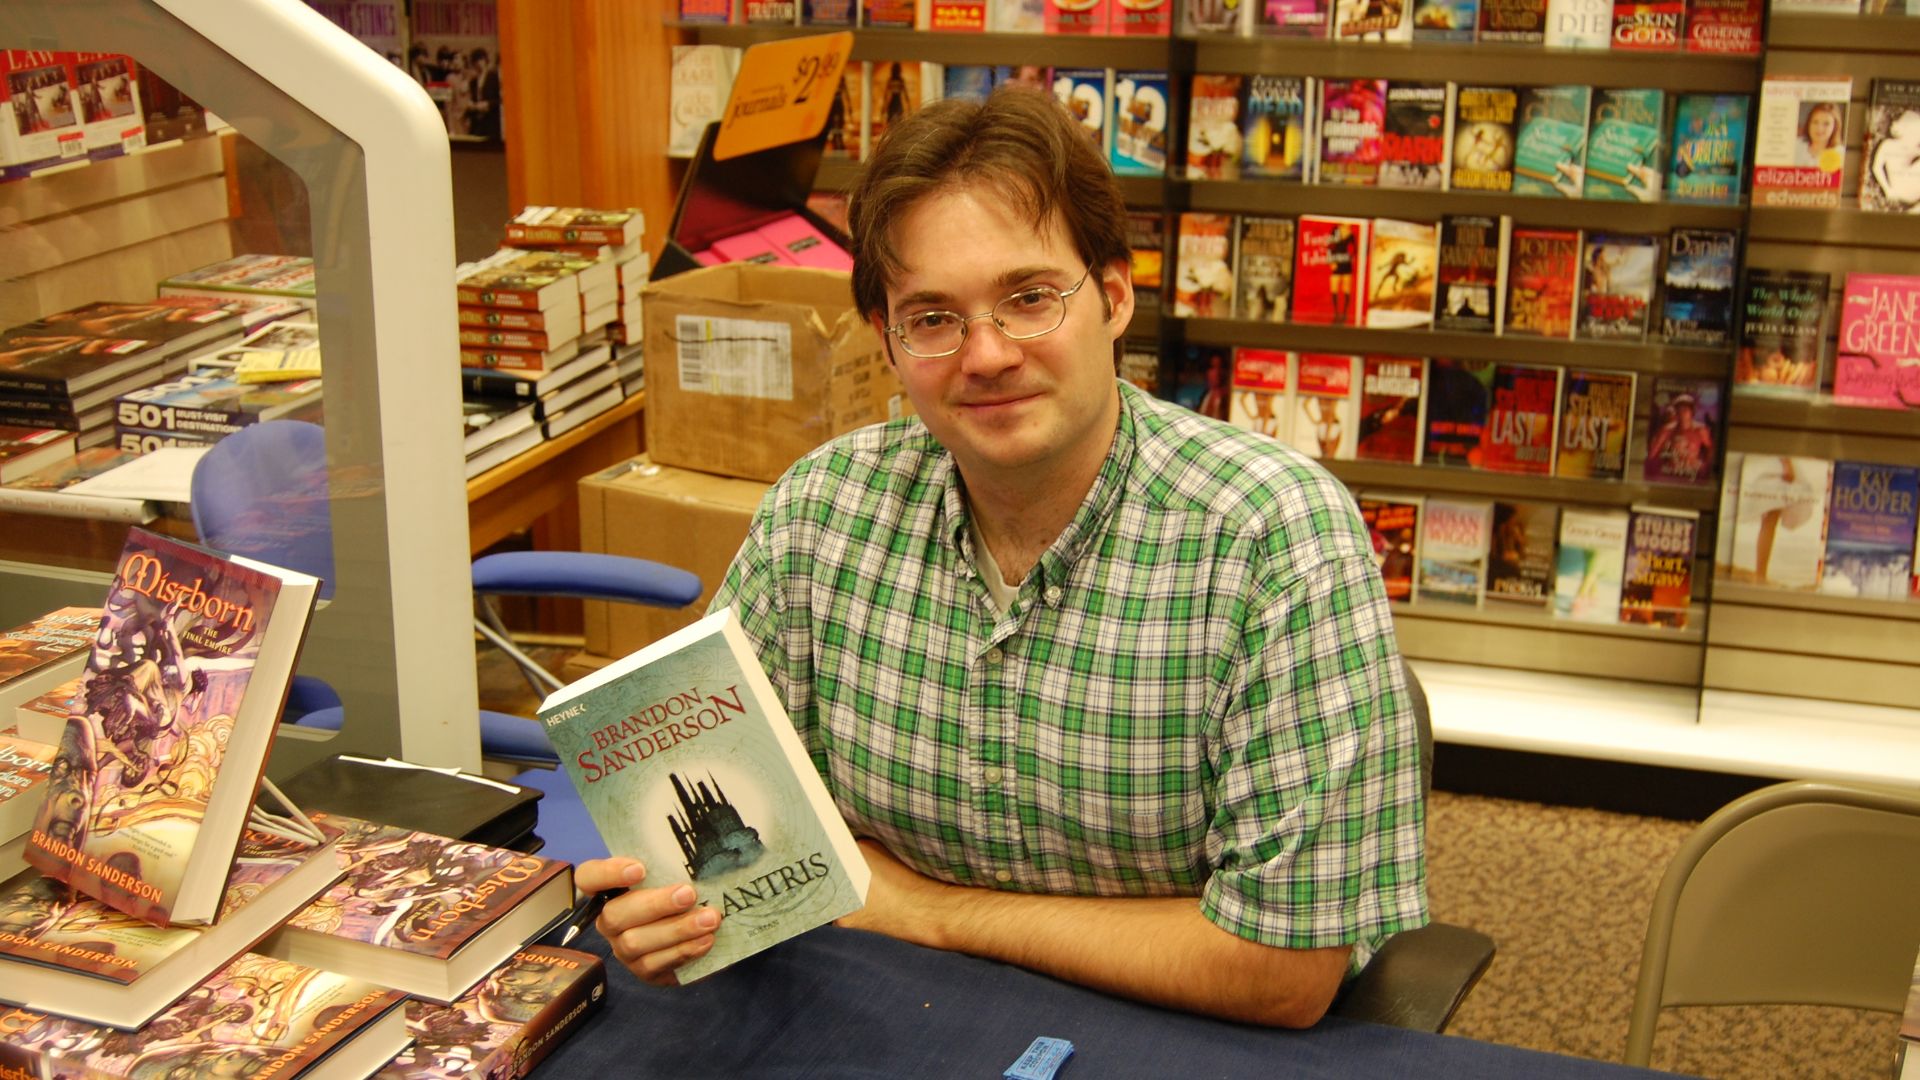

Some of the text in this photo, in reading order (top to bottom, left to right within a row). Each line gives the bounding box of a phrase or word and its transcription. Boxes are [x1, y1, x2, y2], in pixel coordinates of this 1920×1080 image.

[1558, 13, 1606, 33] DIE
[1634, 12, 1677, 27] SKIN
[1615, 24, 1676, 45] GODS
[1251, 87, 1301, 101] NOVAK
[1756, 167, 1833, 187] elizabeth
[1765, 190, 1838, 207] edwards
[1518, 238, 1576, 257] JOHN
[1671, 231, 1735, 258] Daniel
[1778, 288, 1817, 303] Whole
[1862, 286, 1920, 320] JANE
[1746, 304, 1786, 318] World
[1845, 318, 1920, 355] GREEN
[118, 402, 229, 430] 501 MUST-VISIT
[1491, 409, 1537, 445] LAST
[1564, 414, 1610, 450] LAST
[1858, 469, 1894, 497] KAY
[1835, 485, 1913, 513] HOOPER
[1634, 516, 1693, 539] STUART
[1634, 532, 1691, 553] WOODS
[1633, 567, 1686, 588] Straw
[120, 552, 256, 632] Mistborn
[182, 629, 233, 656] FINAL EMPIRE
[202, 626, 219, 639] THE
[546, 705, 581, 727] HEYNE
[591, 687, 703, 751] BRANDON
[577, 685, 747, 784] SANDERSON
[31, 830, 86, 867] BRANDON
[86, 857, 163, 904] SANDERSON
[698, 852, 830, 920] ANTRIS
[409, 856, 545, 942] Mistborn
[748, 919, 780, 937] ROMAN
[41, 941, 139, 969] SANDERSON
[303, 989, 387, 1046] SANDERSON
[544, 998, 588, 1041] SANDERSON
